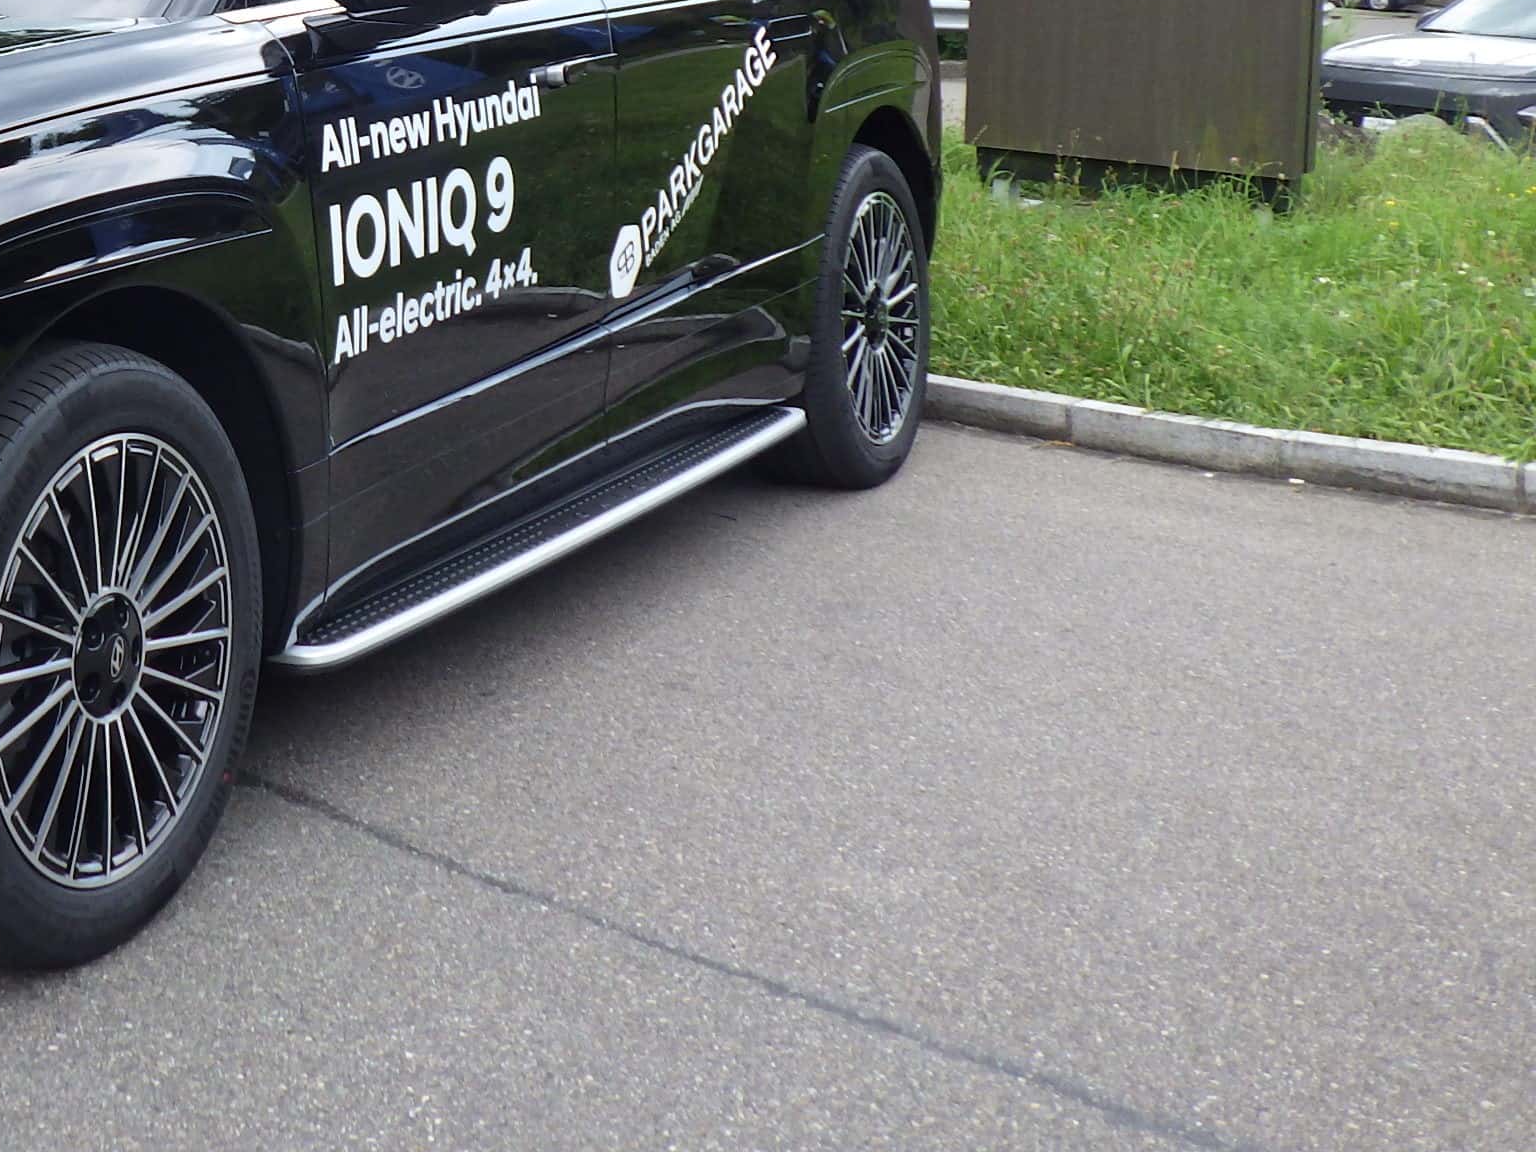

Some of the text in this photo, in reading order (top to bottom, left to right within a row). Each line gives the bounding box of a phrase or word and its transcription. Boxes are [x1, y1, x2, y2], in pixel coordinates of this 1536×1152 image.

[321, 72, 542, 173] All-new Hyundai
[641, 25, 777, 253] PARKGARAGE
[329, 156, 515, 287] IONIQ 9
[334, 247, 539, 365] All-electric. 4x4.
